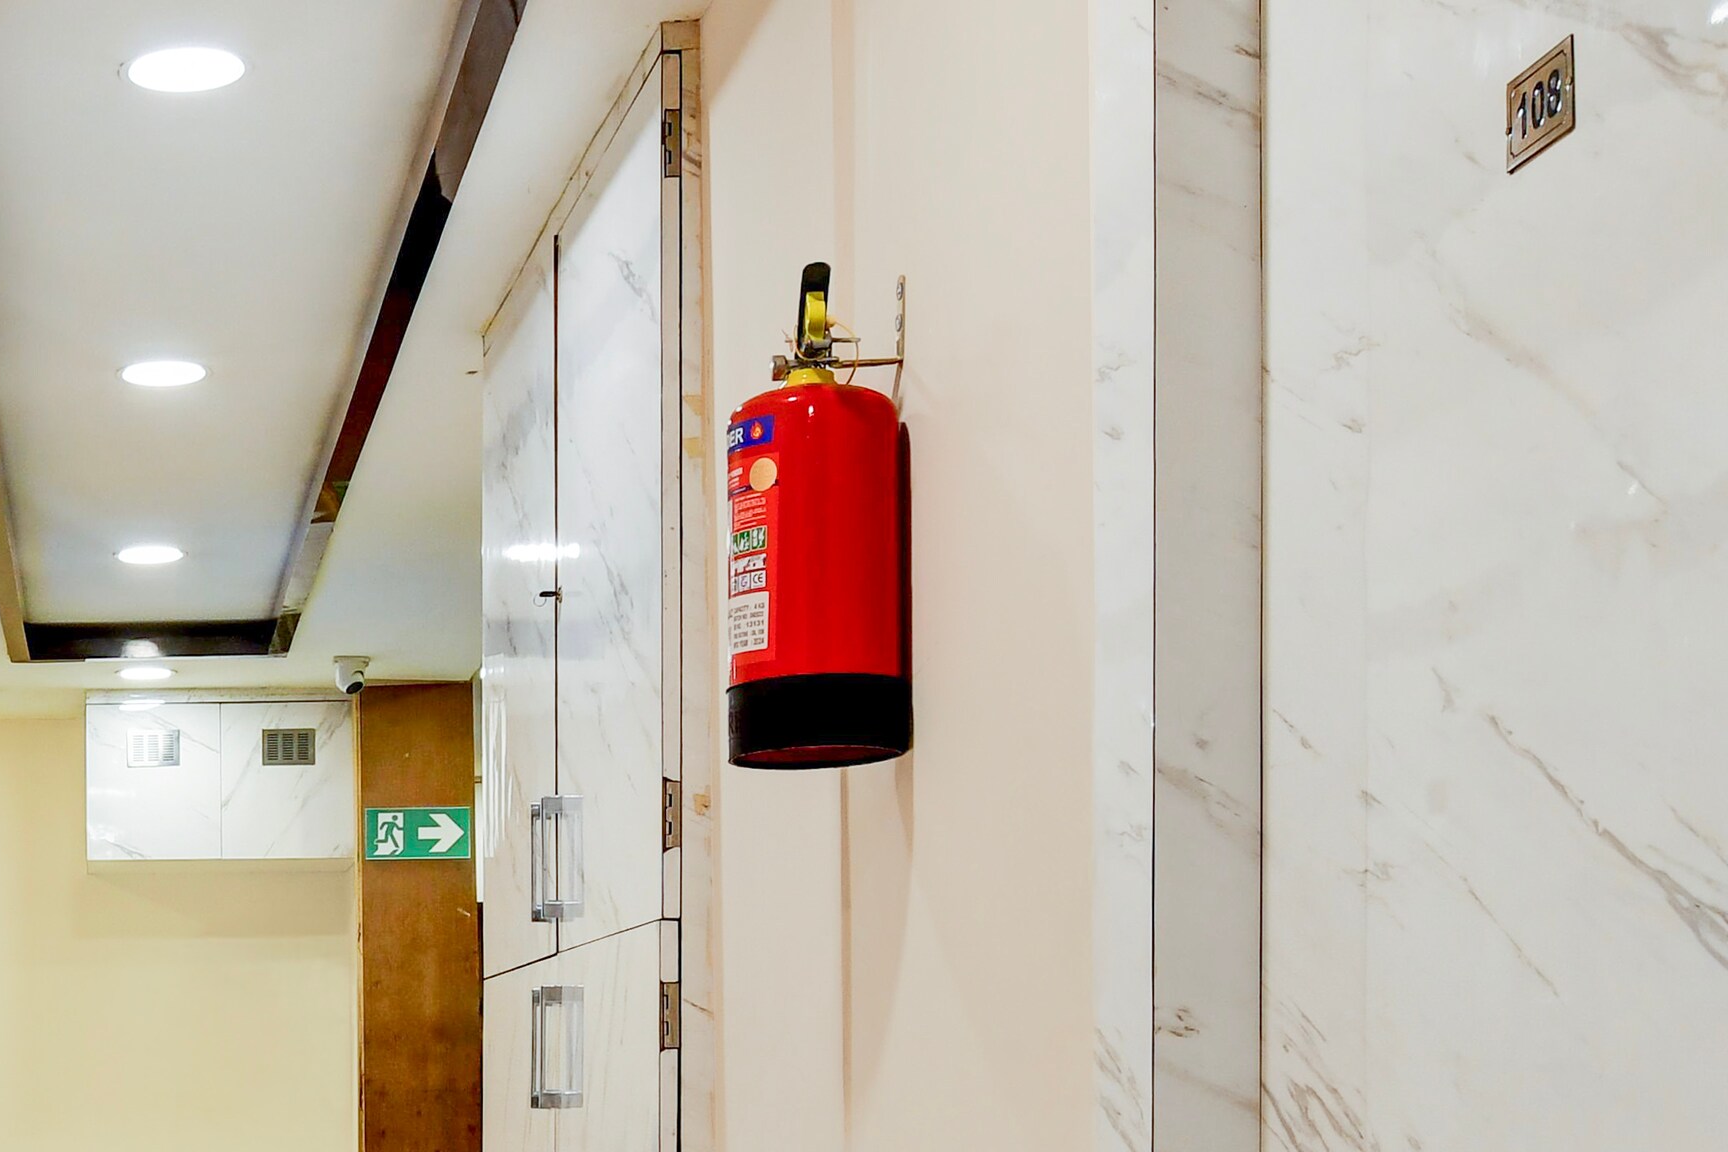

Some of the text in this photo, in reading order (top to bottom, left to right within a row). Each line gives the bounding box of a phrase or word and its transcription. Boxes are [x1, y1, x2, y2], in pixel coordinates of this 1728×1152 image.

[1516, 69, 1563, 140] 108
[727, 427, 744, 447] ER
[752, 573, 763, 584] CE
